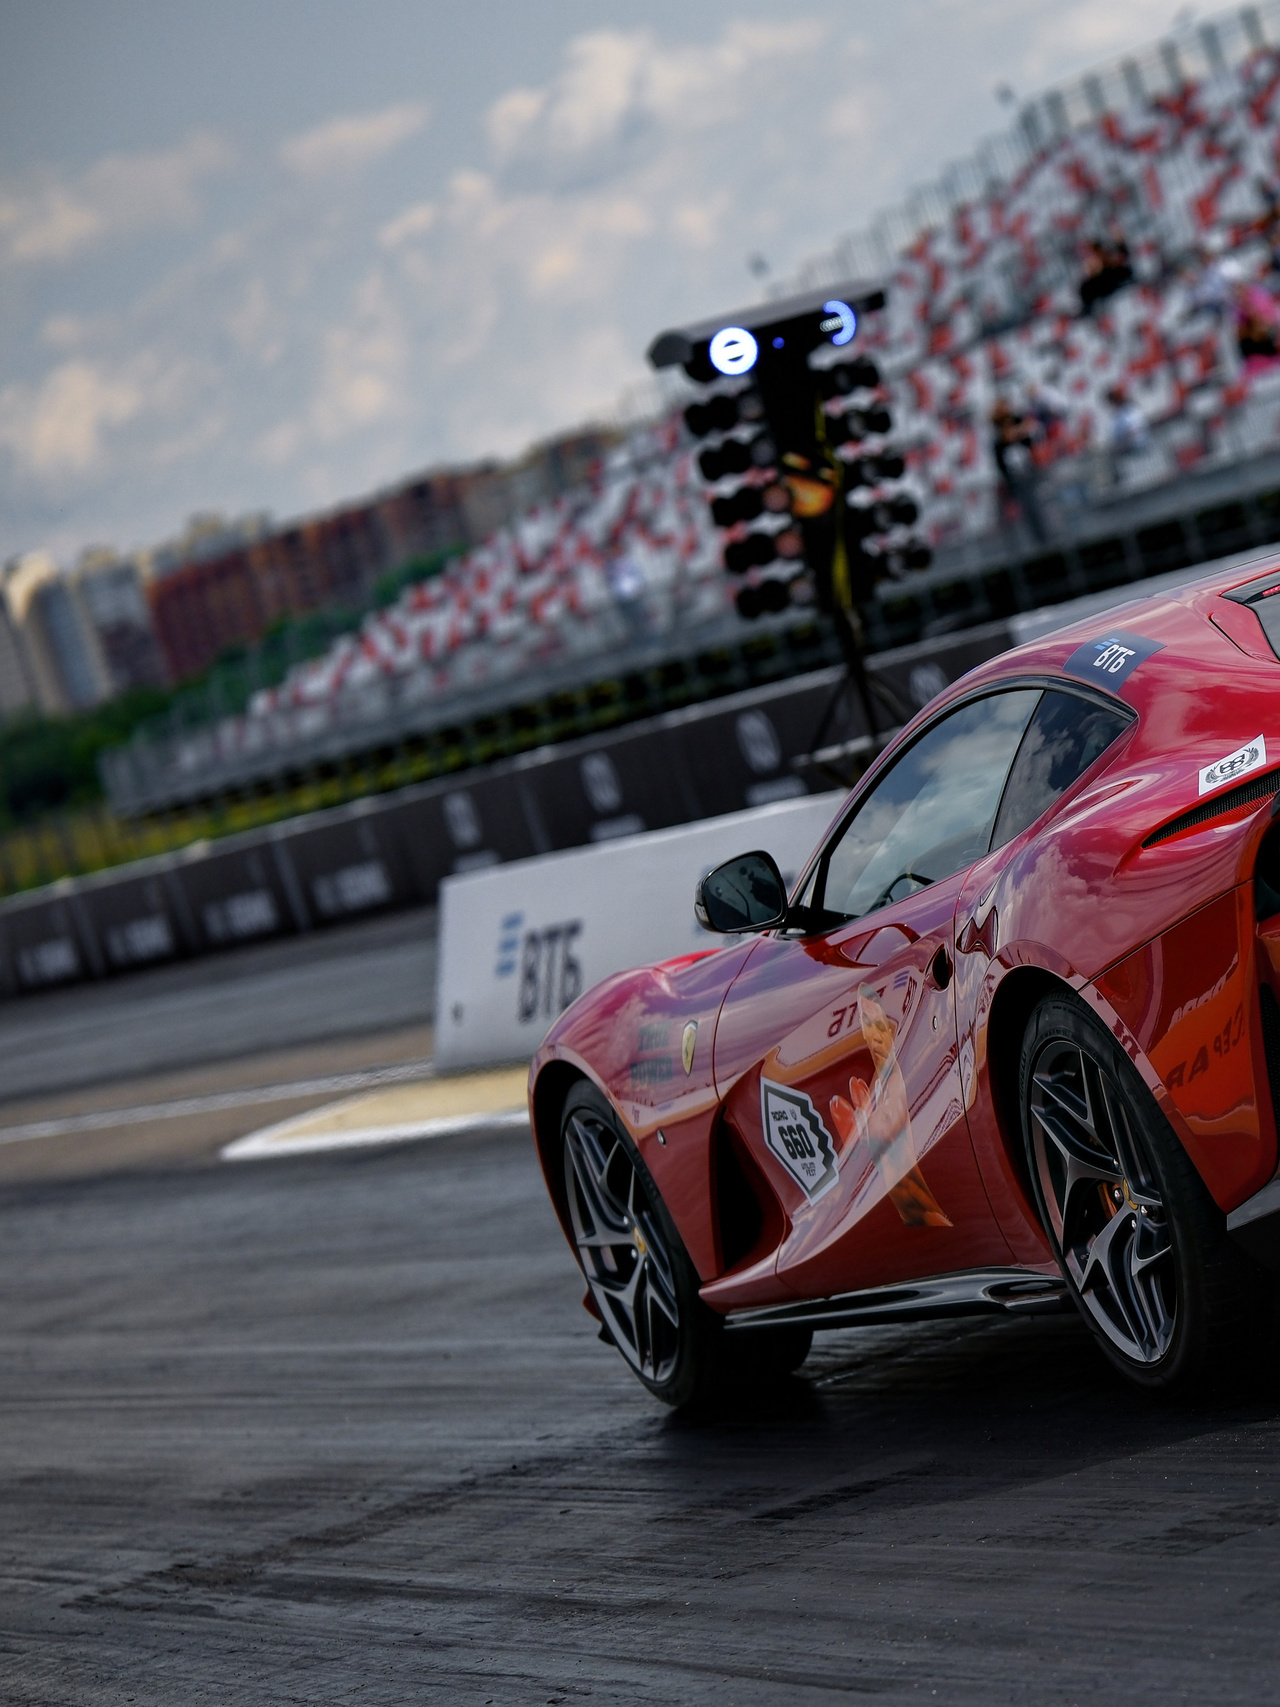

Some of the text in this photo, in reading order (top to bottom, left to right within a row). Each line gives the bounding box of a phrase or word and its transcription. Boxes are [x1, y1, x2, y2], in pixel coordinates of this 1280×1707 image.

[1093, 644, 1136, 673] ВТБ
[519, 918, 583, 1024] ВТБ
[778, 1124, 816, 1159] 660
